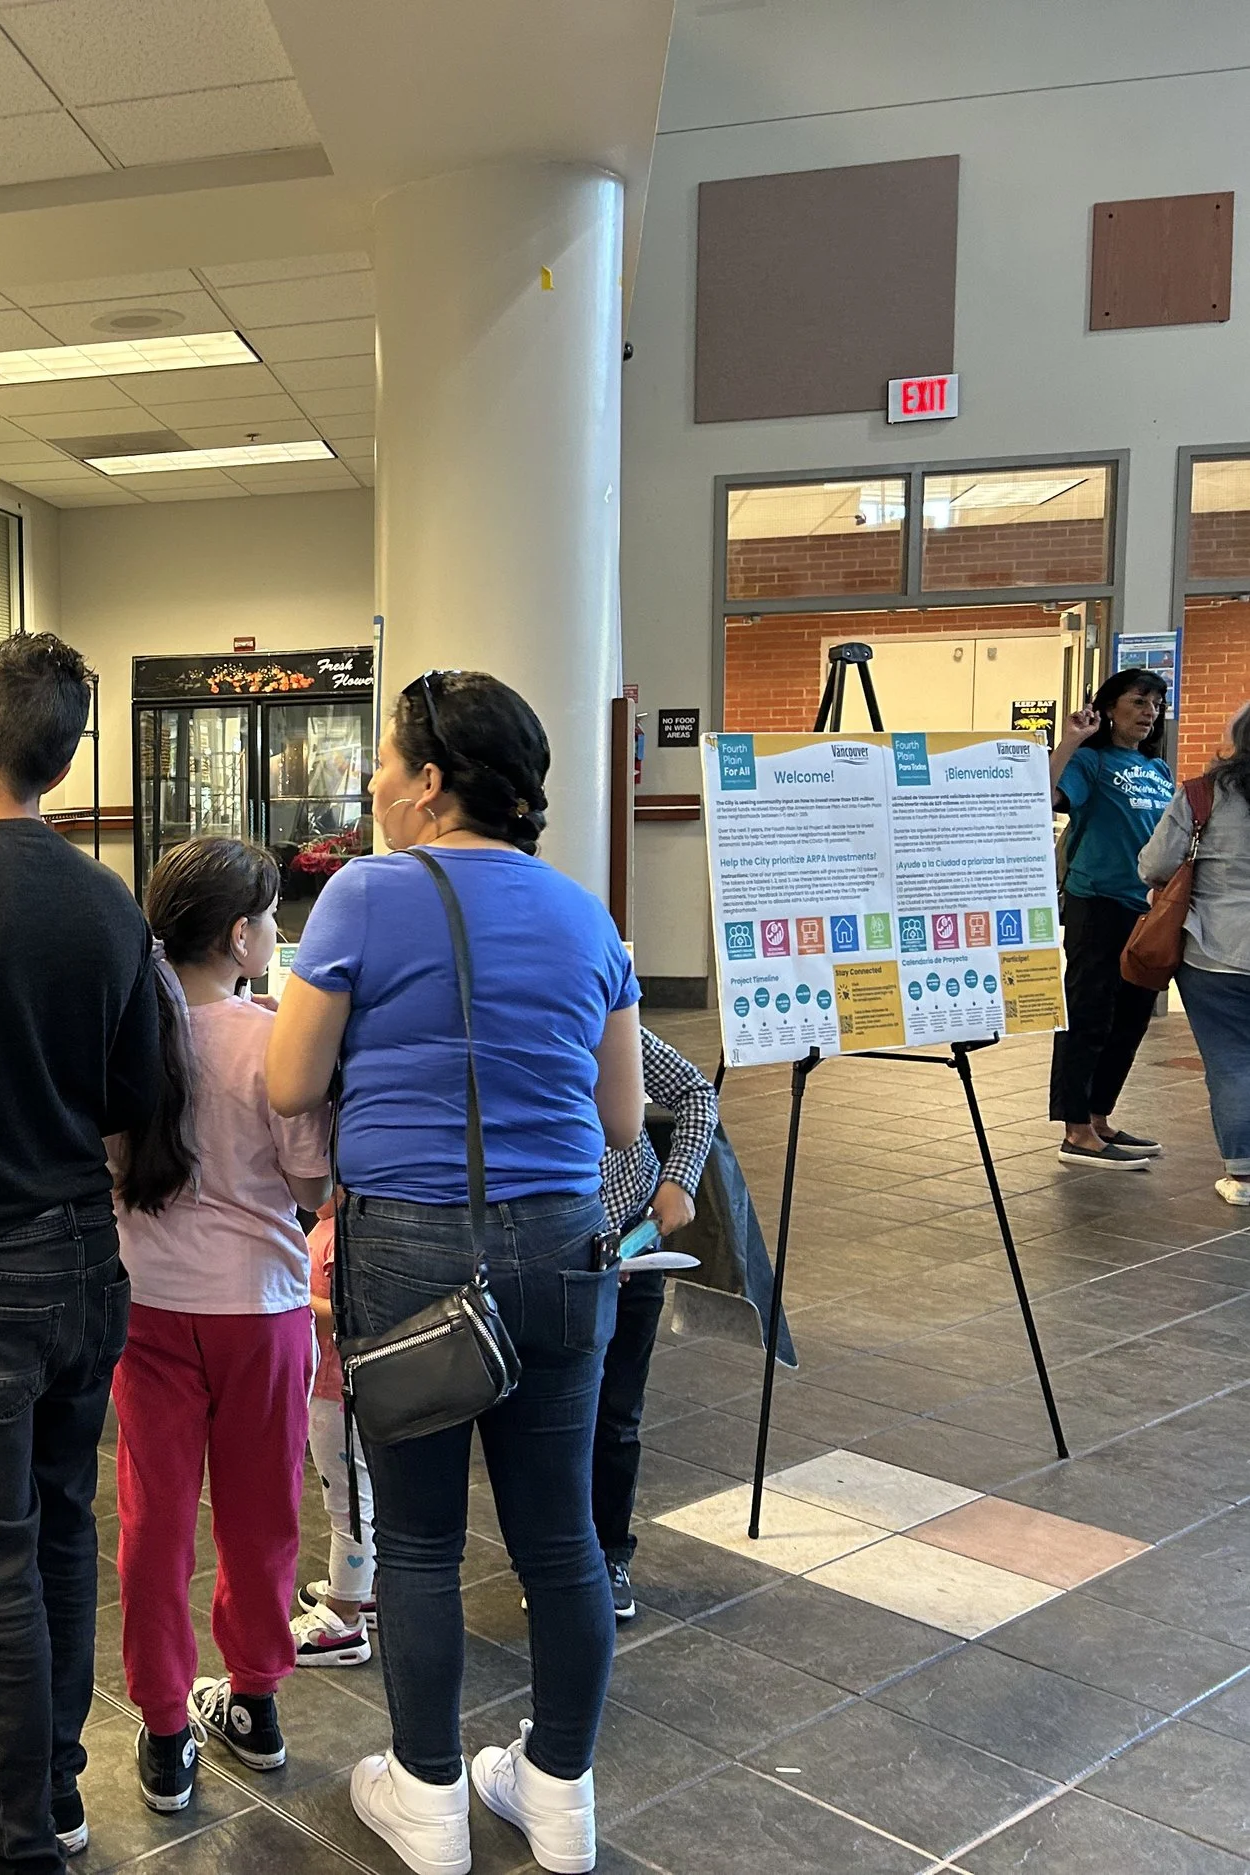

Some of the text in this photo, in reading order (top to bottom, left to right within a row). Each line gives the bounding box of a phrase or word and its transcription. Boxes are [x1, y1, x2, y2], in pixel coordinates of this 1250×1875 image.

[902, 378, 948, 415] EXIT
[317, 658, 353, 674] Fresh
[722, 743, 748, 754] Fourth
[895, 740, 920, 750] Fourth
[996, 742, 1030, 755] Vancouver
[831, 744, 869, 758] Vancouver
[896, 751, 915, 761] Plain
[723, 755, 742, 765] Plain
[724, 766, 750, 776] For All
[911, 763, 927, 771] Todos
[774, 770, 835, 784] Welcome!
[945, 767, 1013, 782] ¡Bienvenidos!
[720, 858, 738, 869] Help
[740, 857, 753, 867] the
[754, 857, 770, 868] City
[772, 855, 805, 868] prioritize
[806, 854, 827, 863] ARPA
[936, 858, 960, 866] Ciudad
[968, 857, 994, 867] priorizar
[943, 955, 968, 964] Proyecto
[835, 967, 882, 977] Stay Connected
[730, 975, 779, 987] Project Timeline
